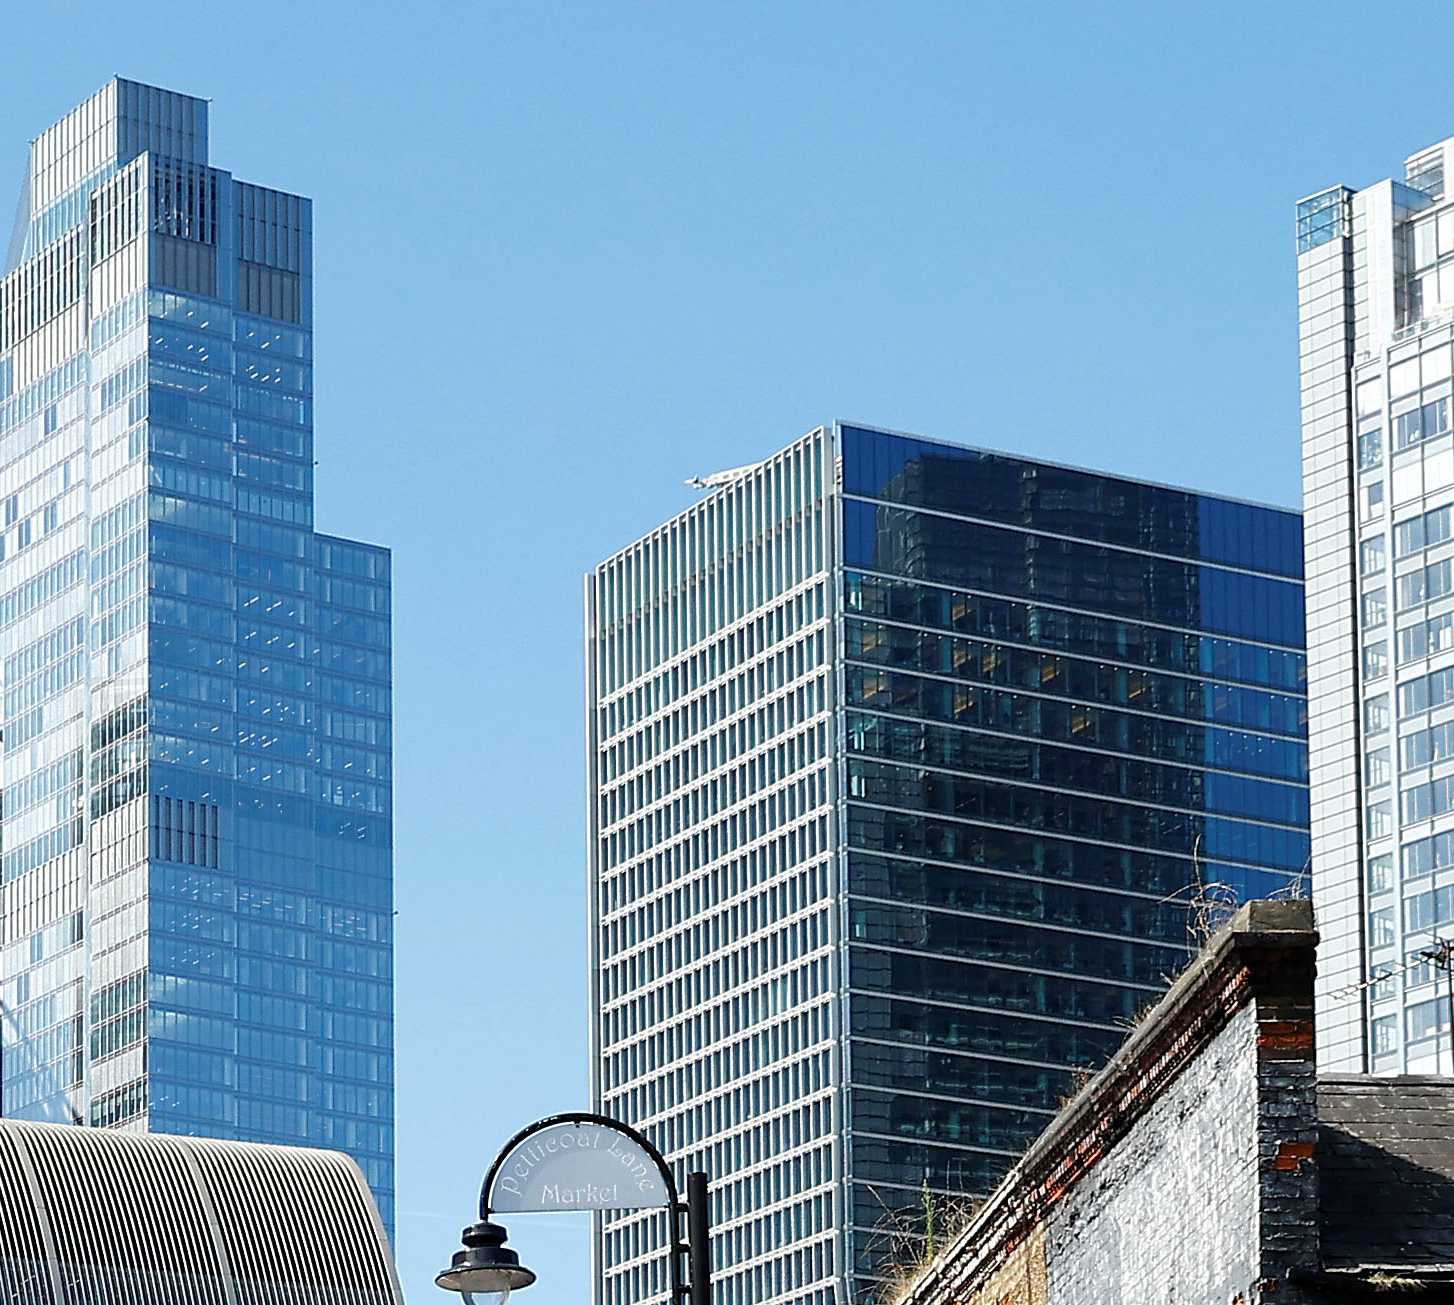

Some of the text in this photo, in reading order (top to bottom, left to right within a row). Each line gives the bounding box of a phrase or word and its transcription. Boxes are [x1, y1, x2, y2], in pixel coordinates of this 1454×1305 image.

[501, 1132, 655, 1198] Petticoat Lane
[541, 1184, 618, 1204] Market
